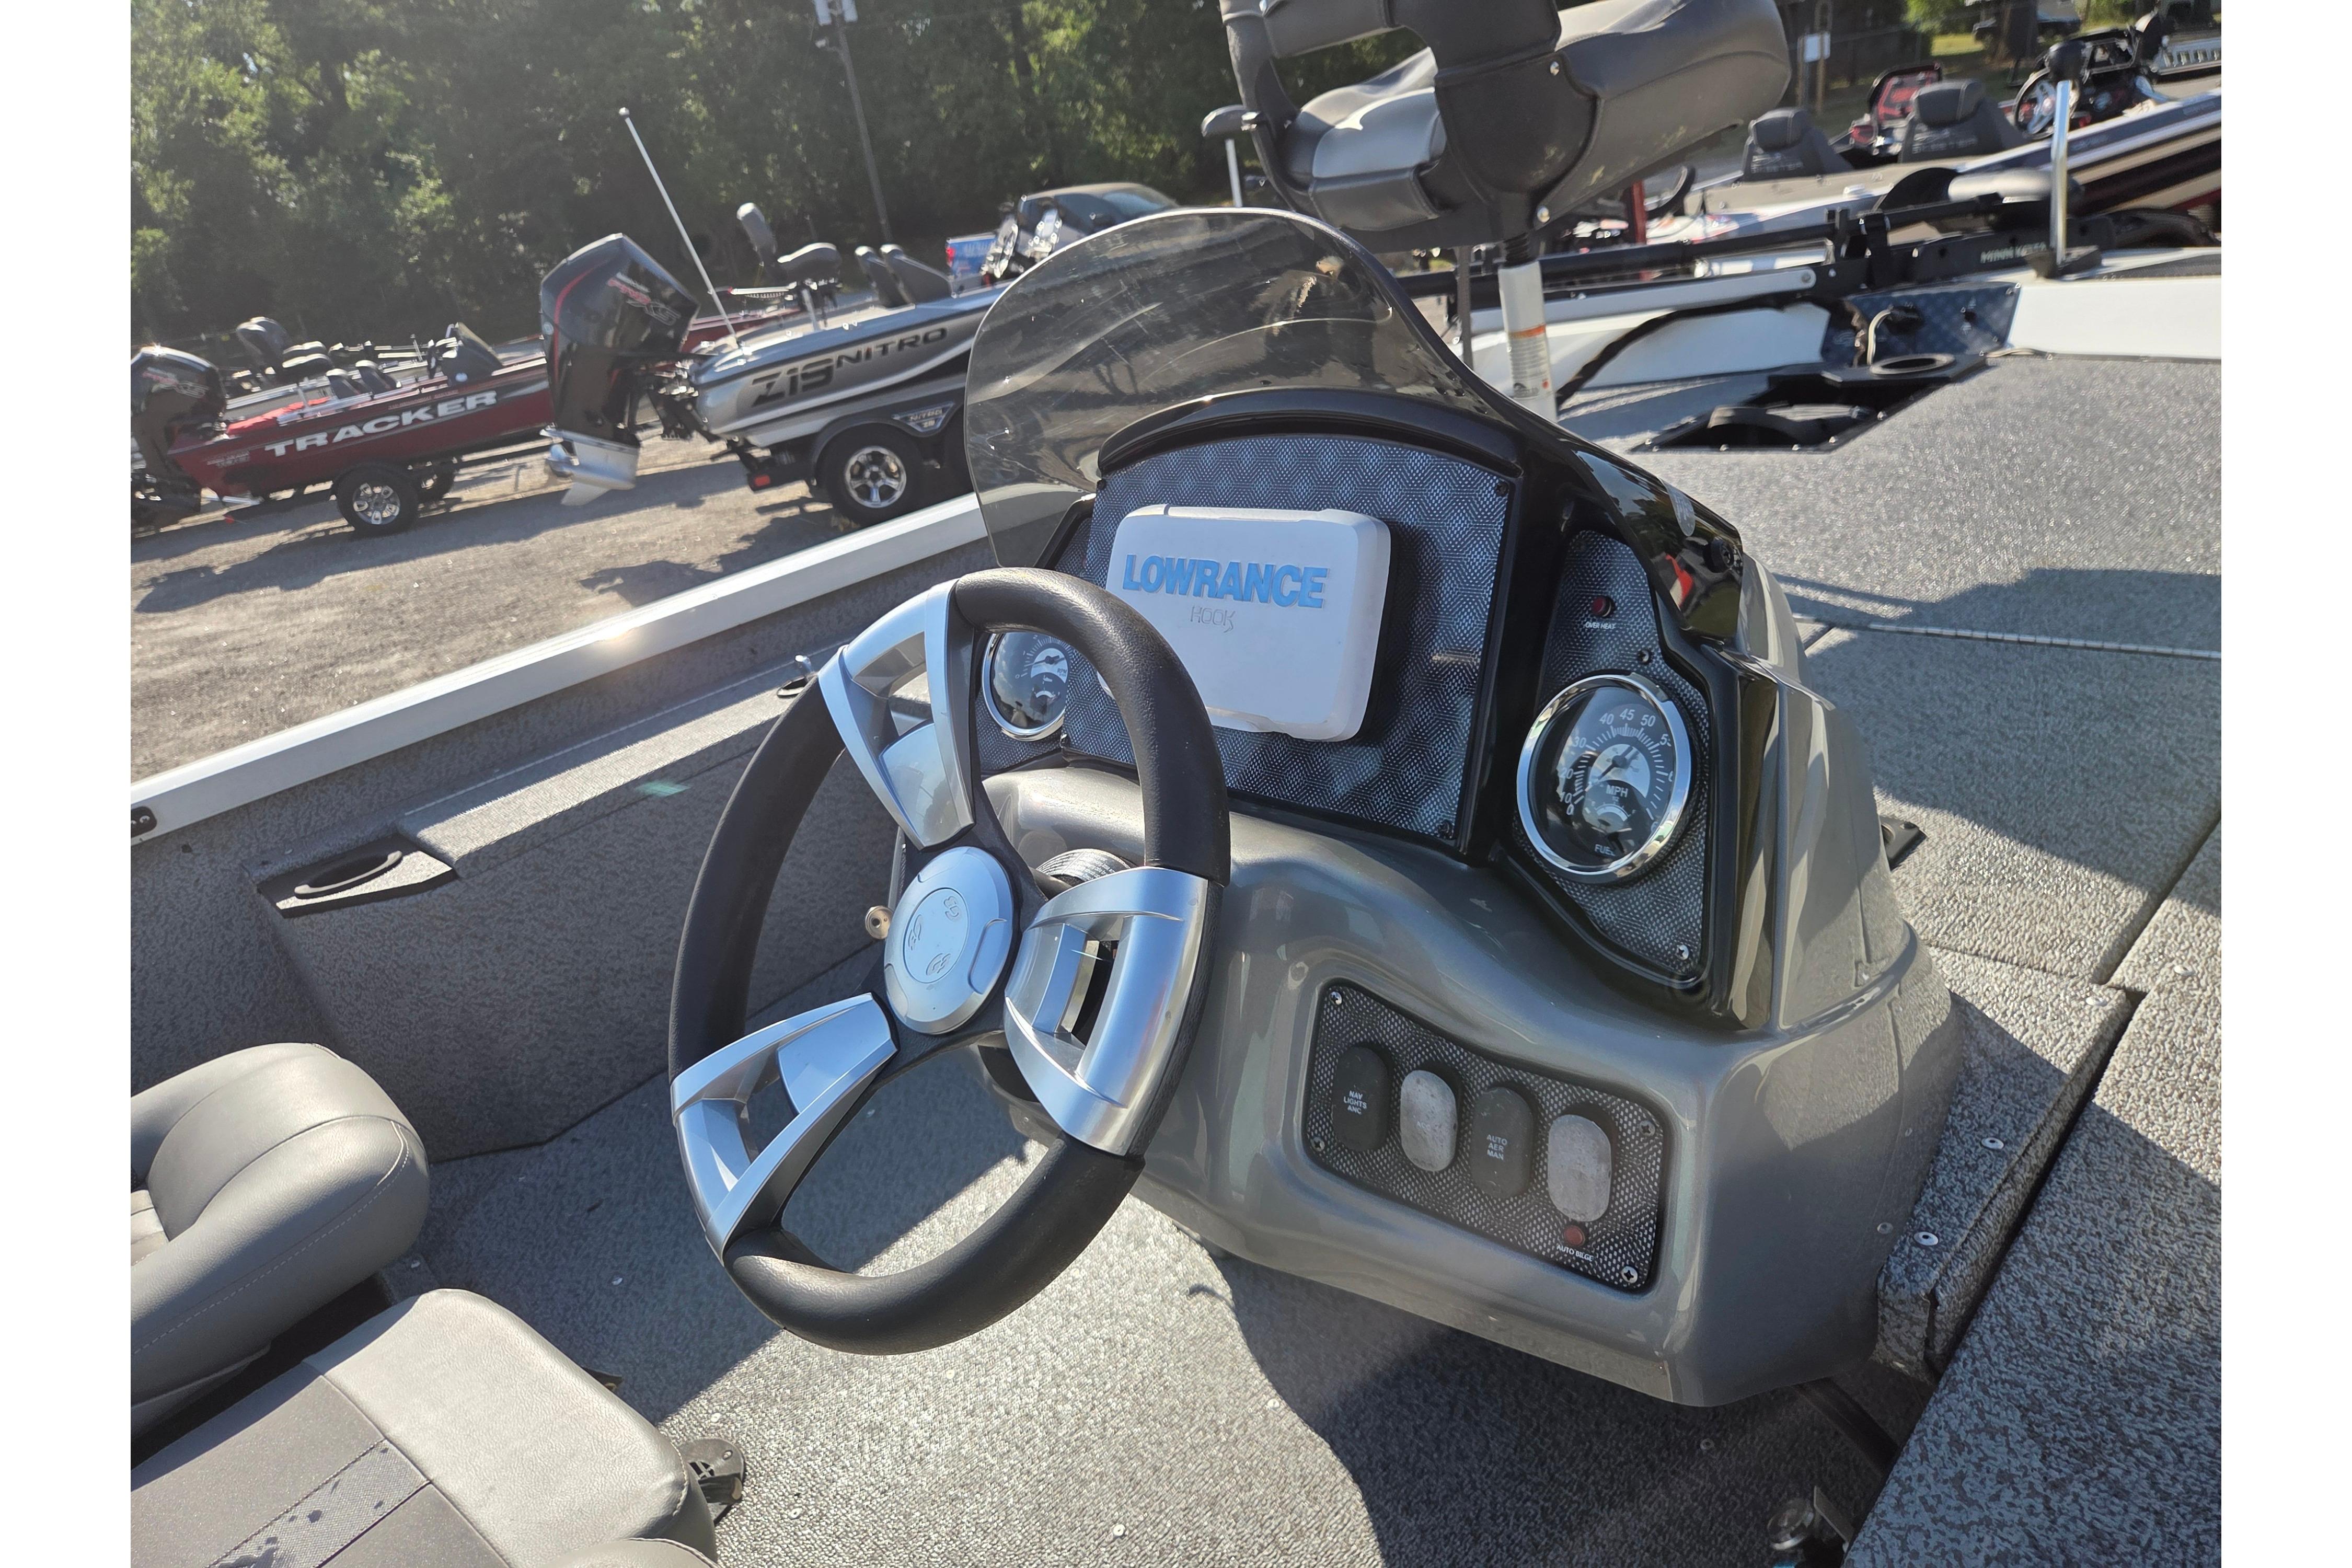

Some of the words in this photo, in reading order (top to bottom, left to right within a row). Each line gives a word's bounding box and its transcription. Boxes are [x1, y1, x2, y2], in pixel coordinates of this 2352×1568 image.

[836, 328, 947, 369] NITRO
[265, 390, 497, 457] TRACKER
[1123, 554, 1329, 609] LOWRANCE
[1190, 605, 1236, 633] HOOK
[1599, 712, 1614, 725] 40
[1620, 708, 1635, 721] 45
[1641, 714, 1656, 727] 50
[1572, 736, 1587, 748] 30
[1559, 767, 1574, 779] 20
[1606, 785, 1629, 798] MPH
[1566, 803, 1574, 815] 0
[1595, 844, 1616, 857] FUEL
[1349, 1090, 1363, 1100] NAV
[1343, 1096, 1367, 1110] LIGHTS
[1347, 1105, 1362, 1115] ANC
[1486, 1134, 1507, 1146] AUTO
[1488, 1142, 1504, 1152] AER
[1487, 1149, 1504, 1160] MAN
[1557, 1244, 1575, 1255] AUTO
[1575, 1250, 1594, 1262] BILGE
